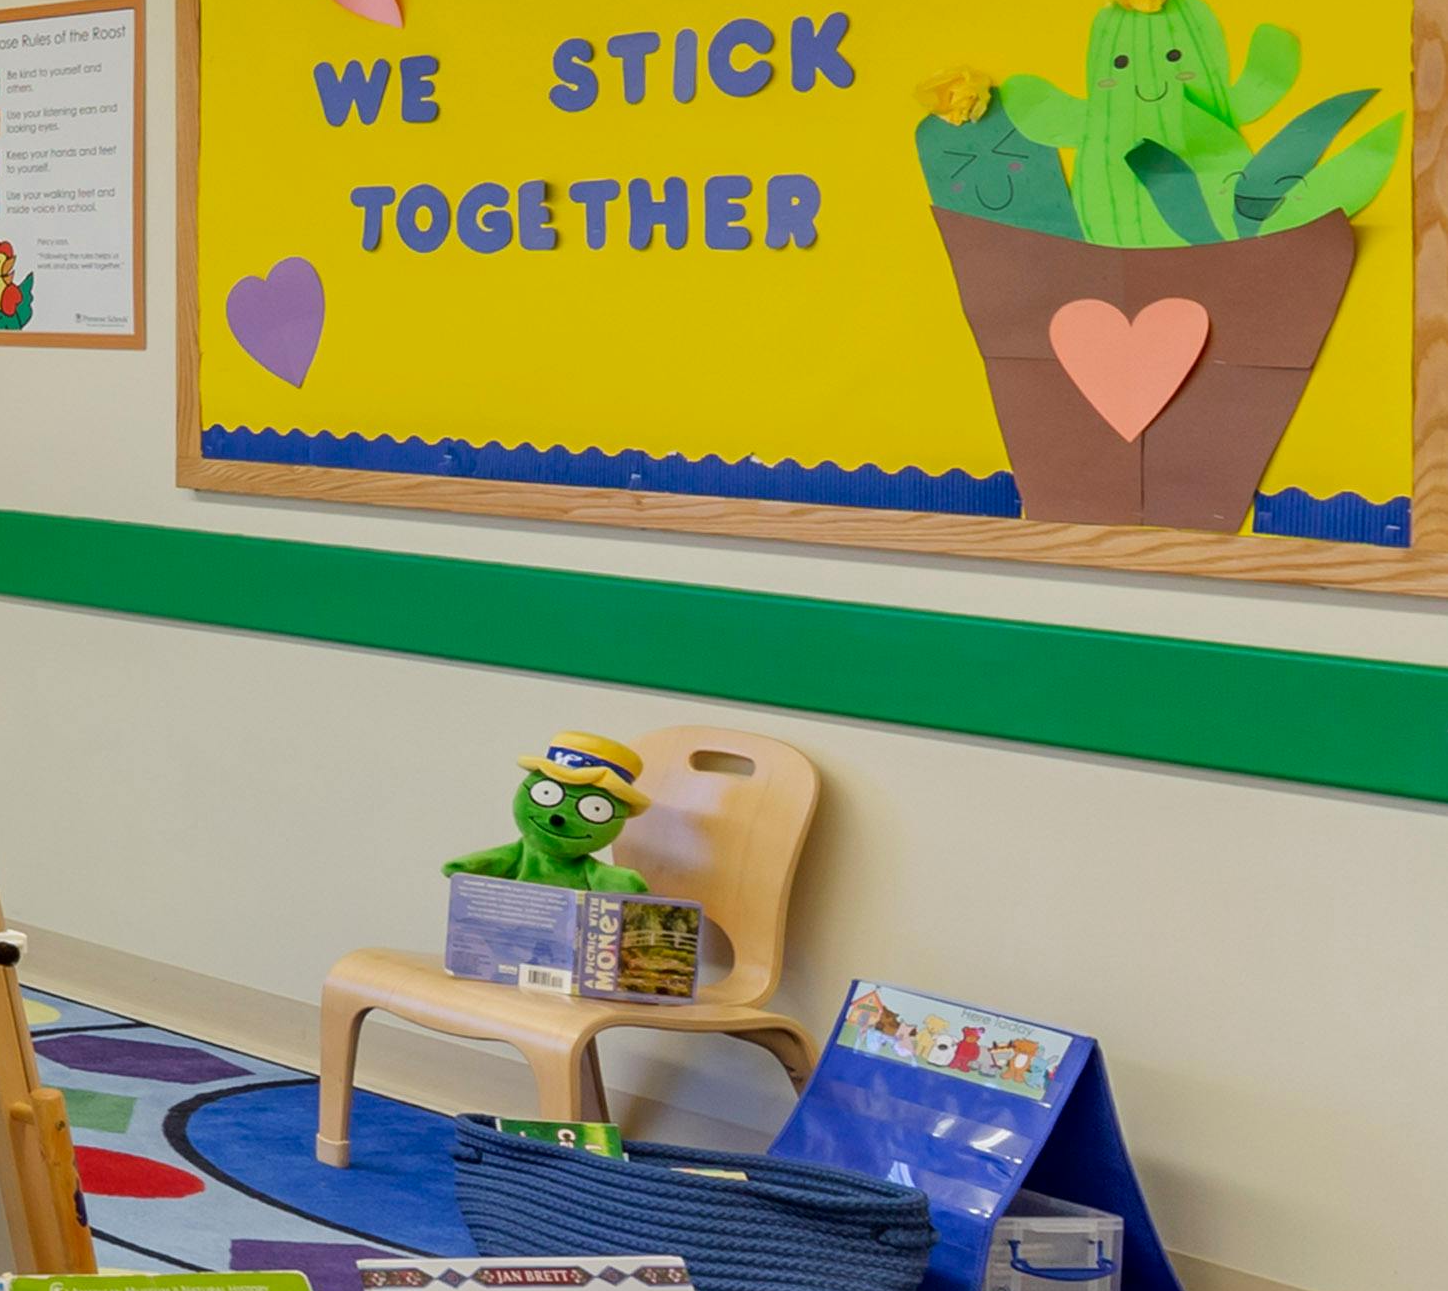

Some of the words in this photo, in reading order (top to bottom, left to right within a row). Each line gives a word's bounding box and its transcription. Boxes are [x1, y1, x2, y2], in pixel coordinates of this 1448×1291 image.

[22, 33, 51, 47] Rules
[54, 30, 67, 45] of
[70, 29, 88, 42] the
[93, 26, 127, 40] Roost
[7, 70, 18, 80] Be
[19, 68, 37, 79] kind
[39, 68, 48, 77] to
[49, 64, 82, 77] yourself
[83, 63, 102, 74] and
[313, 54, 440, 127] WE
[549, 11, 855, 113] STICK
[6, 110, 21, 120] Use
[23, 110, 41, 119] your
[42, 106, 77, 118] listening
[99, 104, 117, 113] and
[6, 124, 37, 134] looking
[6, 150, 29, 160] Keep
[30, 150, 48, 159] your
[50, 148, 76, 157] hands
[78, 146, 97, 156] and
[98, 145, 117, 155] feet
[6, 165, 15, 174] to
[6, 191, 20, 200] Use
[23, 191, 41, 200] your
[43, 190, 76, 200] walking
[78, 188, 95, 198] feet
[97, 188, 115, 197] and
[6, 205, 30, 214] inside
[32, 205, 55, 213] voice
[57, 204, 65, 212] in
[350, 173, 822, 254] TOGETHER
[588, 897, 599, 927] WITH
[585, 932, 598, 974] PICNIC
[584, 977, 596, 989] A
[960, 1008, 992, 1025] Here
[994, 1016, 1035, 1037] Today
[495, 1270, 522, 1283] JAN
[525, 1269, 569, 1282] BRETT
